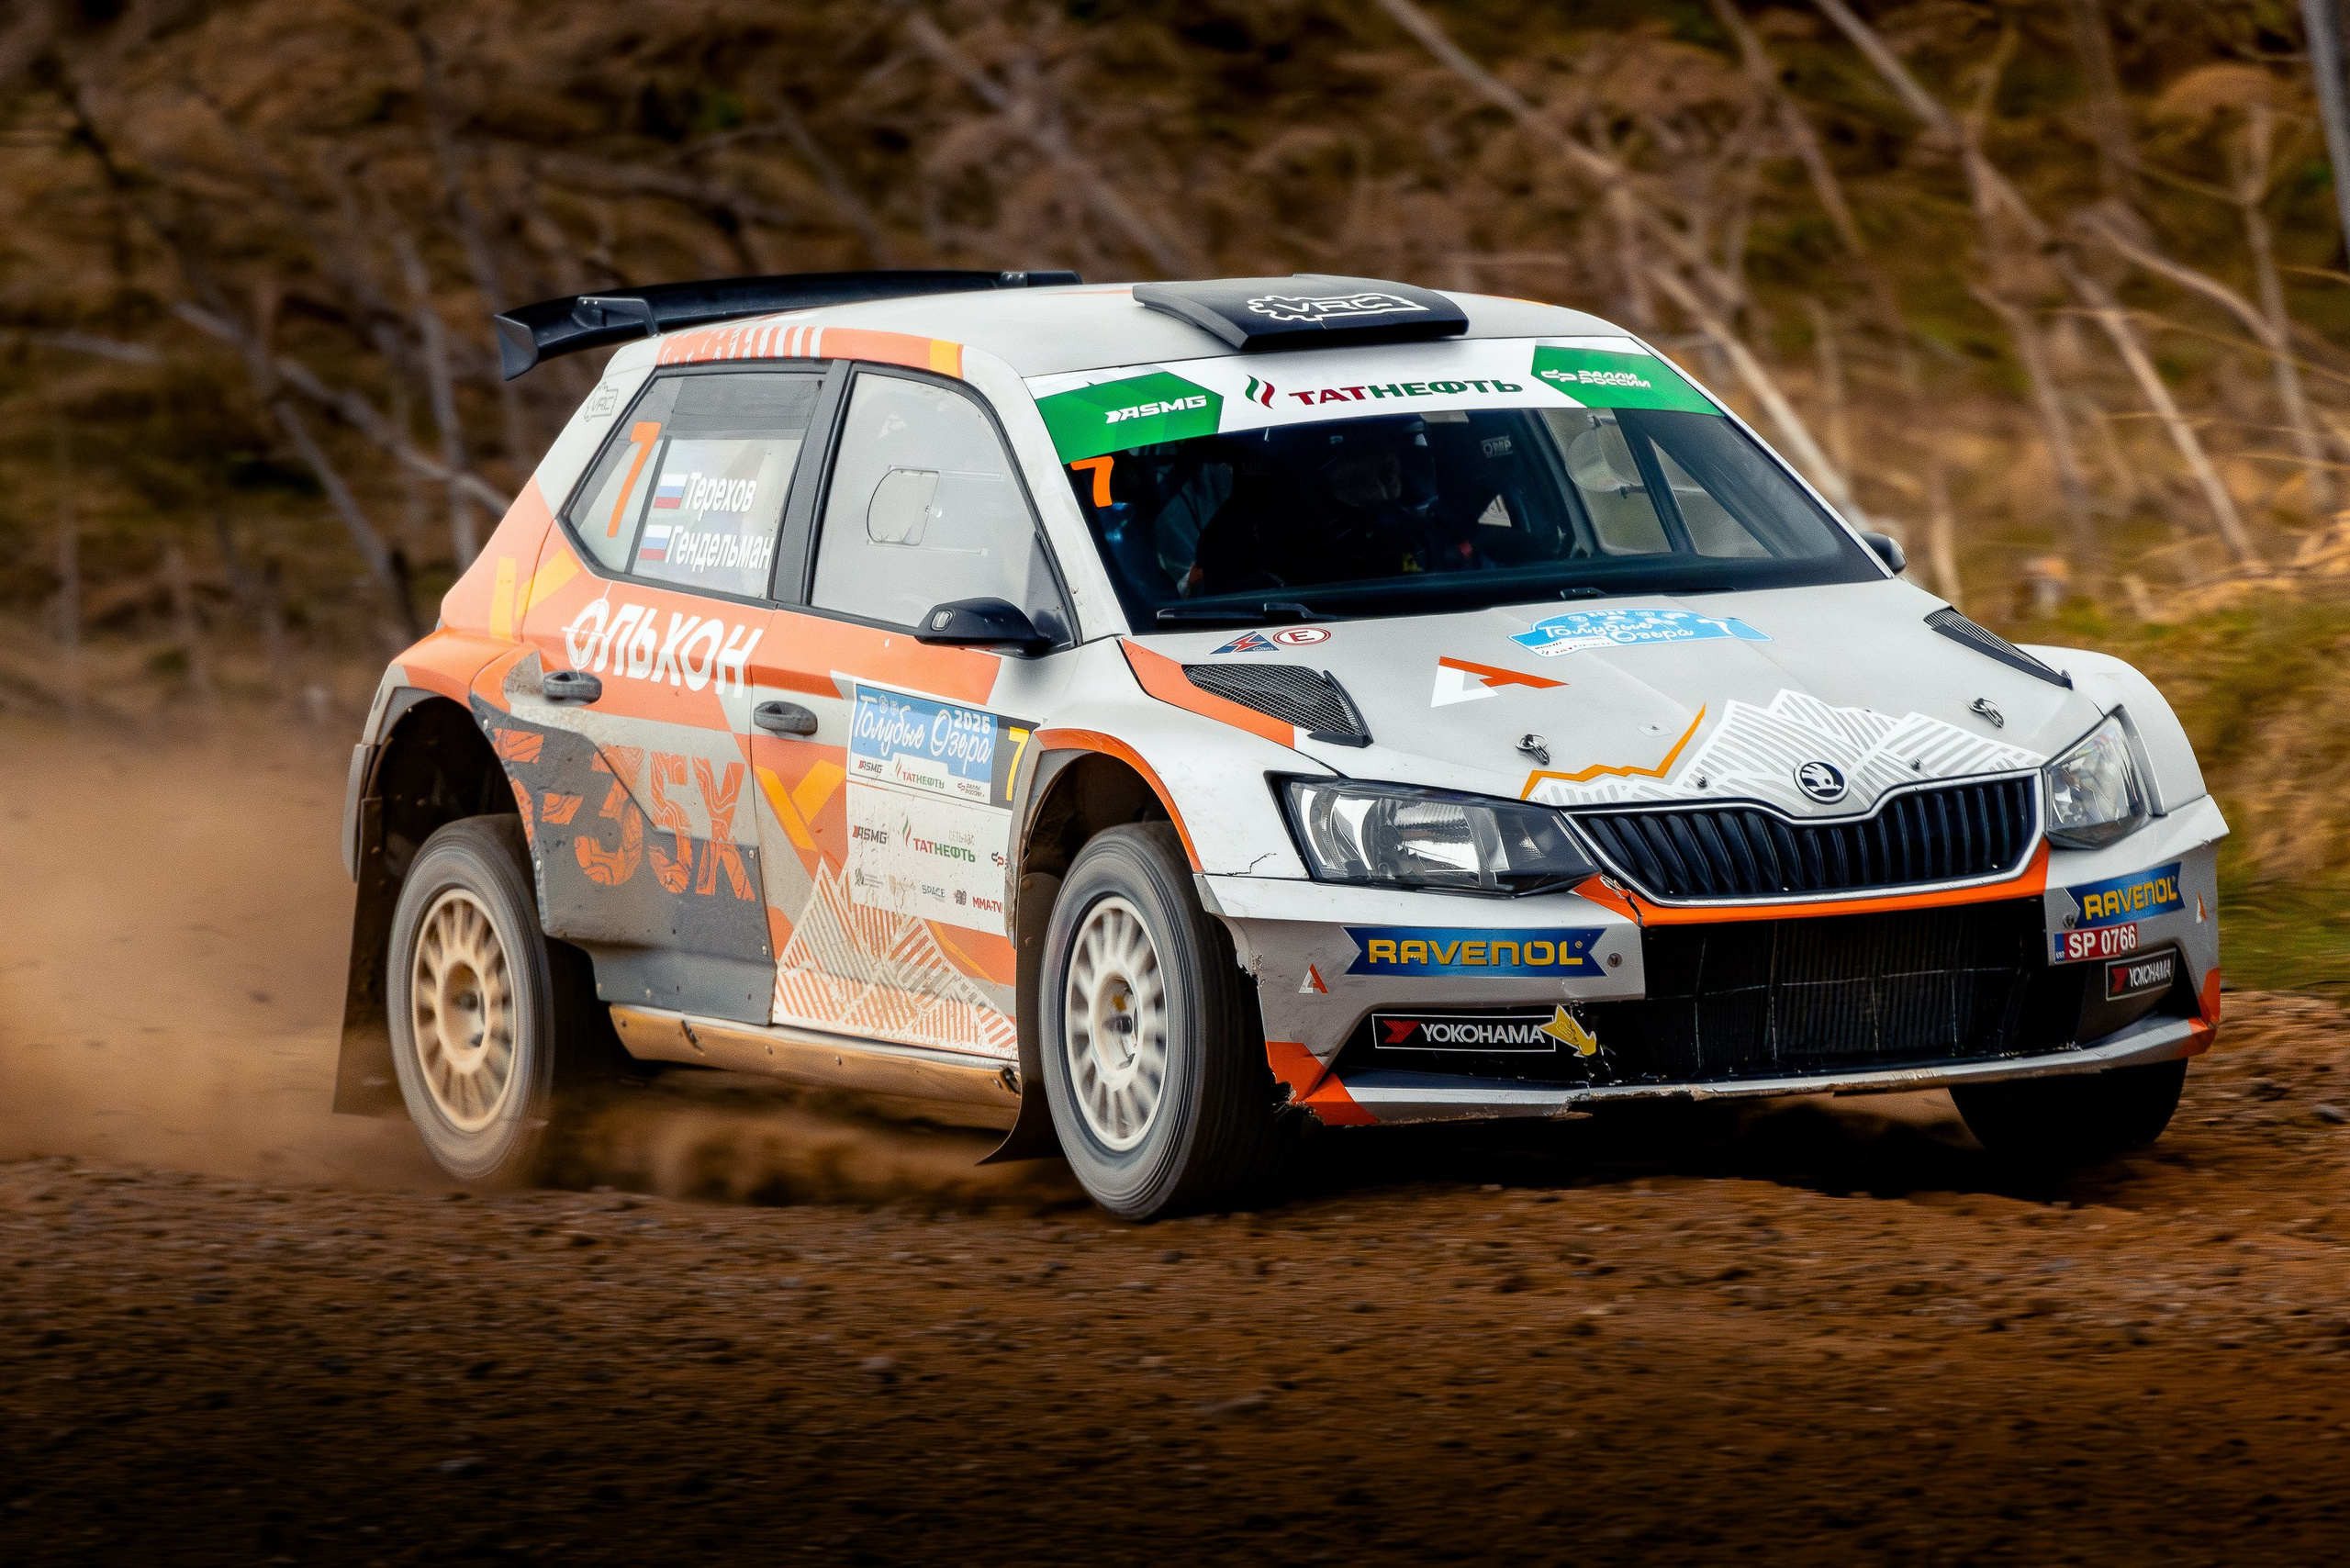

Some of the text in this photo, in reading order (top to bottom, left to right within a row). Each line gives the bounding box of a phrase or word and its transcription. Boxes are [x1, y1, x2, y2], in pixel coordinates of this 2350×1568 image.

[1275, 296, 1393, 314] VRC
[1288, 379, 1524, 406] ТАТНЕФТЬ
[606, 421, 662, 538] 7
[1070, 455, 1115, 508] 7
[685, 473, 757, 521] Терехов
[665, 526, 775, 573] Гендельман
[1288, 630, 1315, 642] E
[855, 695, 992, 775] Голубые Озера
[954, 710, 991, 734] 2026
[1005, 726, 1030, 801] 7
[902, 771, 945, 790] ТАТНЕФТЬ
[912, 837, 976, 863] ТАТНЕФТЬ
[922, 884, 946, 899] SPACE
[2083, 878, 2177, 921] RAVENOL
[1368, 939, 1584, 967] RAVENOL
[2068, 924, 2137, 958] SP 0766
[2129, 958, 2171, 988] YOKOHAMA
[1420, 1023, 1546, 1044] YOKOHAMA
